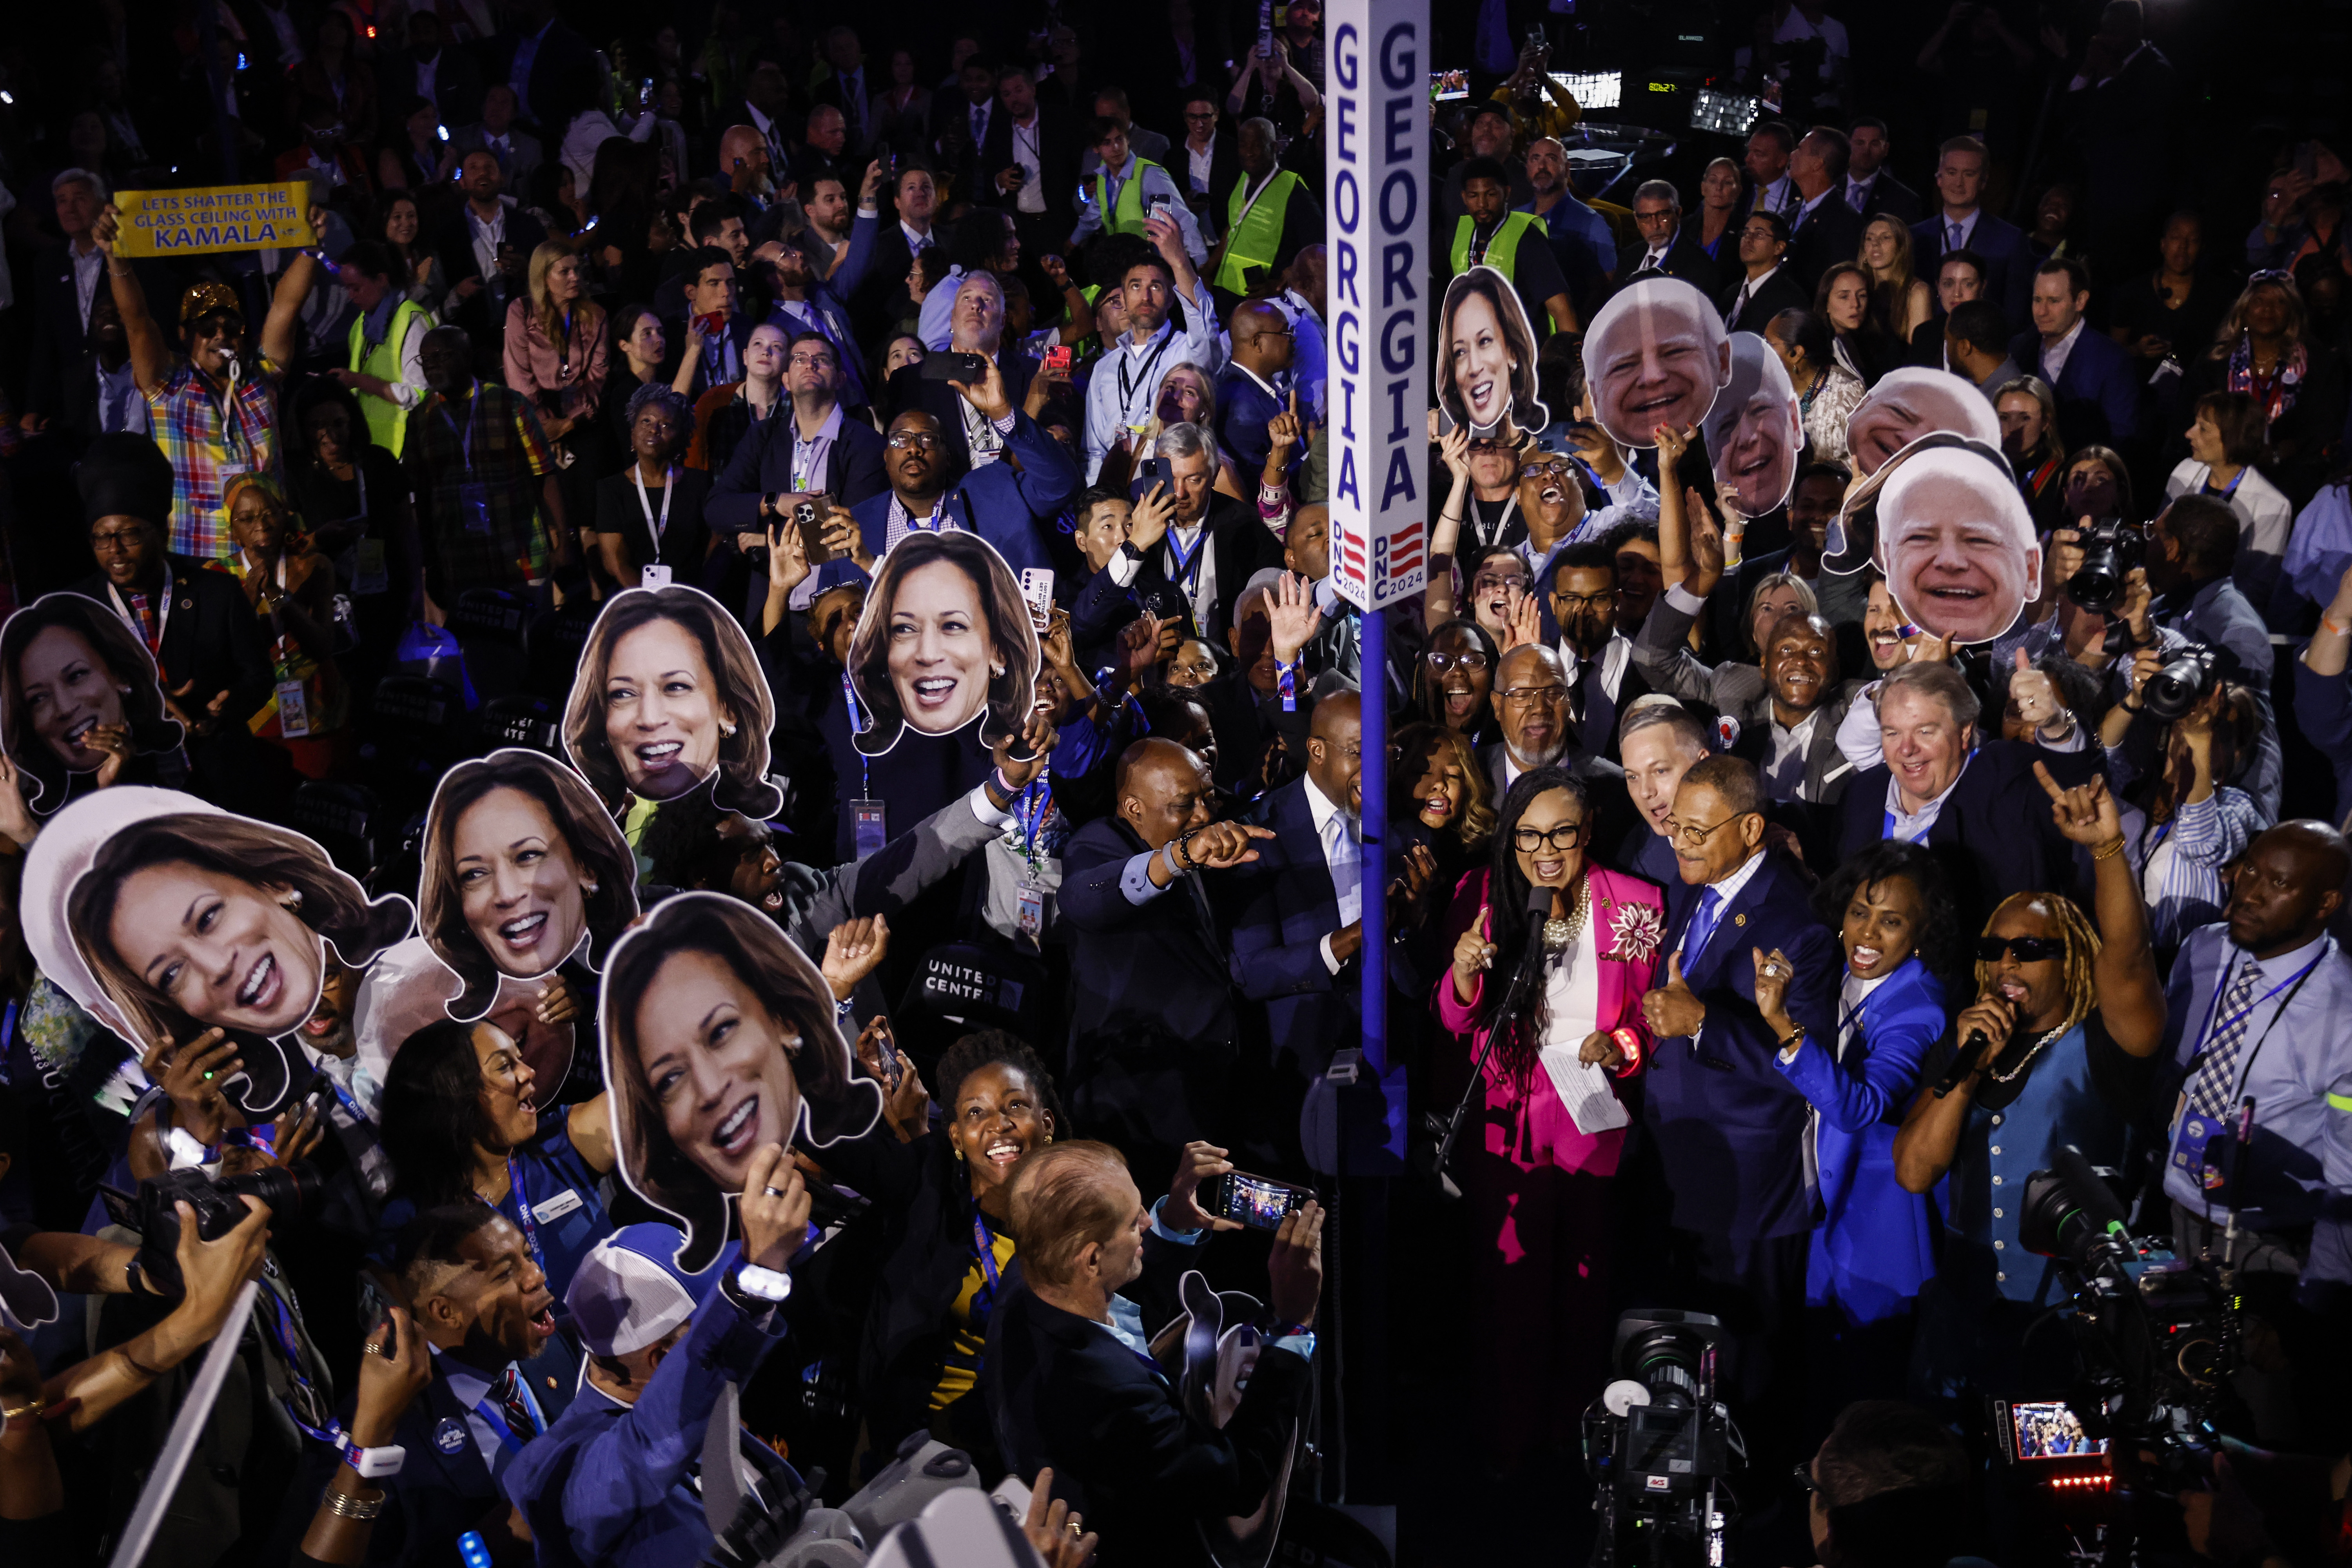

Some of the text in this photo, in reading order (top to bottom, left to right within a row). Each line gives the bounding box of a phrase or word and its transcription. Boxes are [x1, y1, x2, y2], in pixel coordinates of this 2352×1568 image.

[143, 191, 287, 210] LETS SHATTER THE
[135, 207, 297, 227] GLASS CEILING WITH
[156, 224, 277, 248] KAMALA
[1334, 22, 1360, 512] GEORGIA
[1379, 22, 1417, 513] GEORGIA
[1374, 536, 1387, 600] DNC
[1344, 578, 1366, 602] 2024
[1390, 571, 1422, 595] 2024
[845, 688, 854, 704] DNC
[1472, 731, 1480, 743] DN
[928, 959, 997, 986] UNITED
[925, 976, 993, 1004] CENTER
[348, 1100, 365, 1121] DNC
[519, 1203, 540, 1253] DNC 2024
